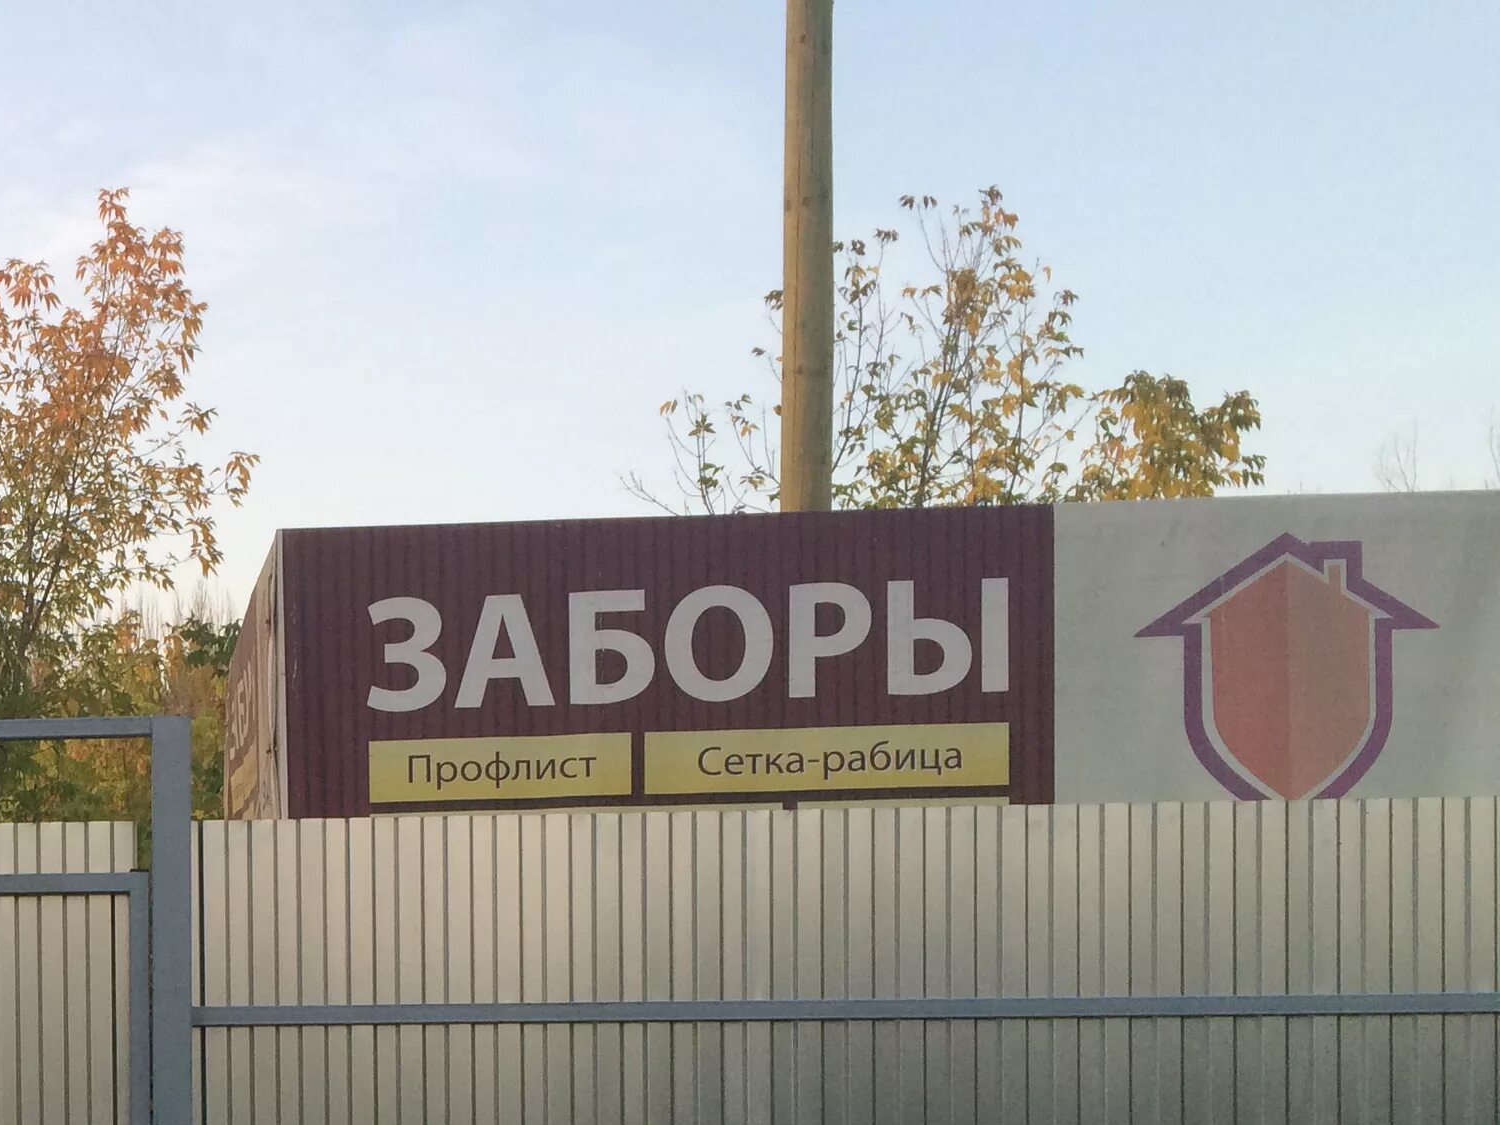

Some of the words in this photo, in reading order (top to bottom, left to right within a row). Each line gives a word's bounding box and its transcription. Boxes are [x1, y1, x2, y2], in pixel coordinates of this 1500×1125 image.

[366, 577, 1010, 713] ЗАБОРЫ
[407, 751, 597, 790] Профлист
[697, 740, 963, 780] Сетка-рабица
